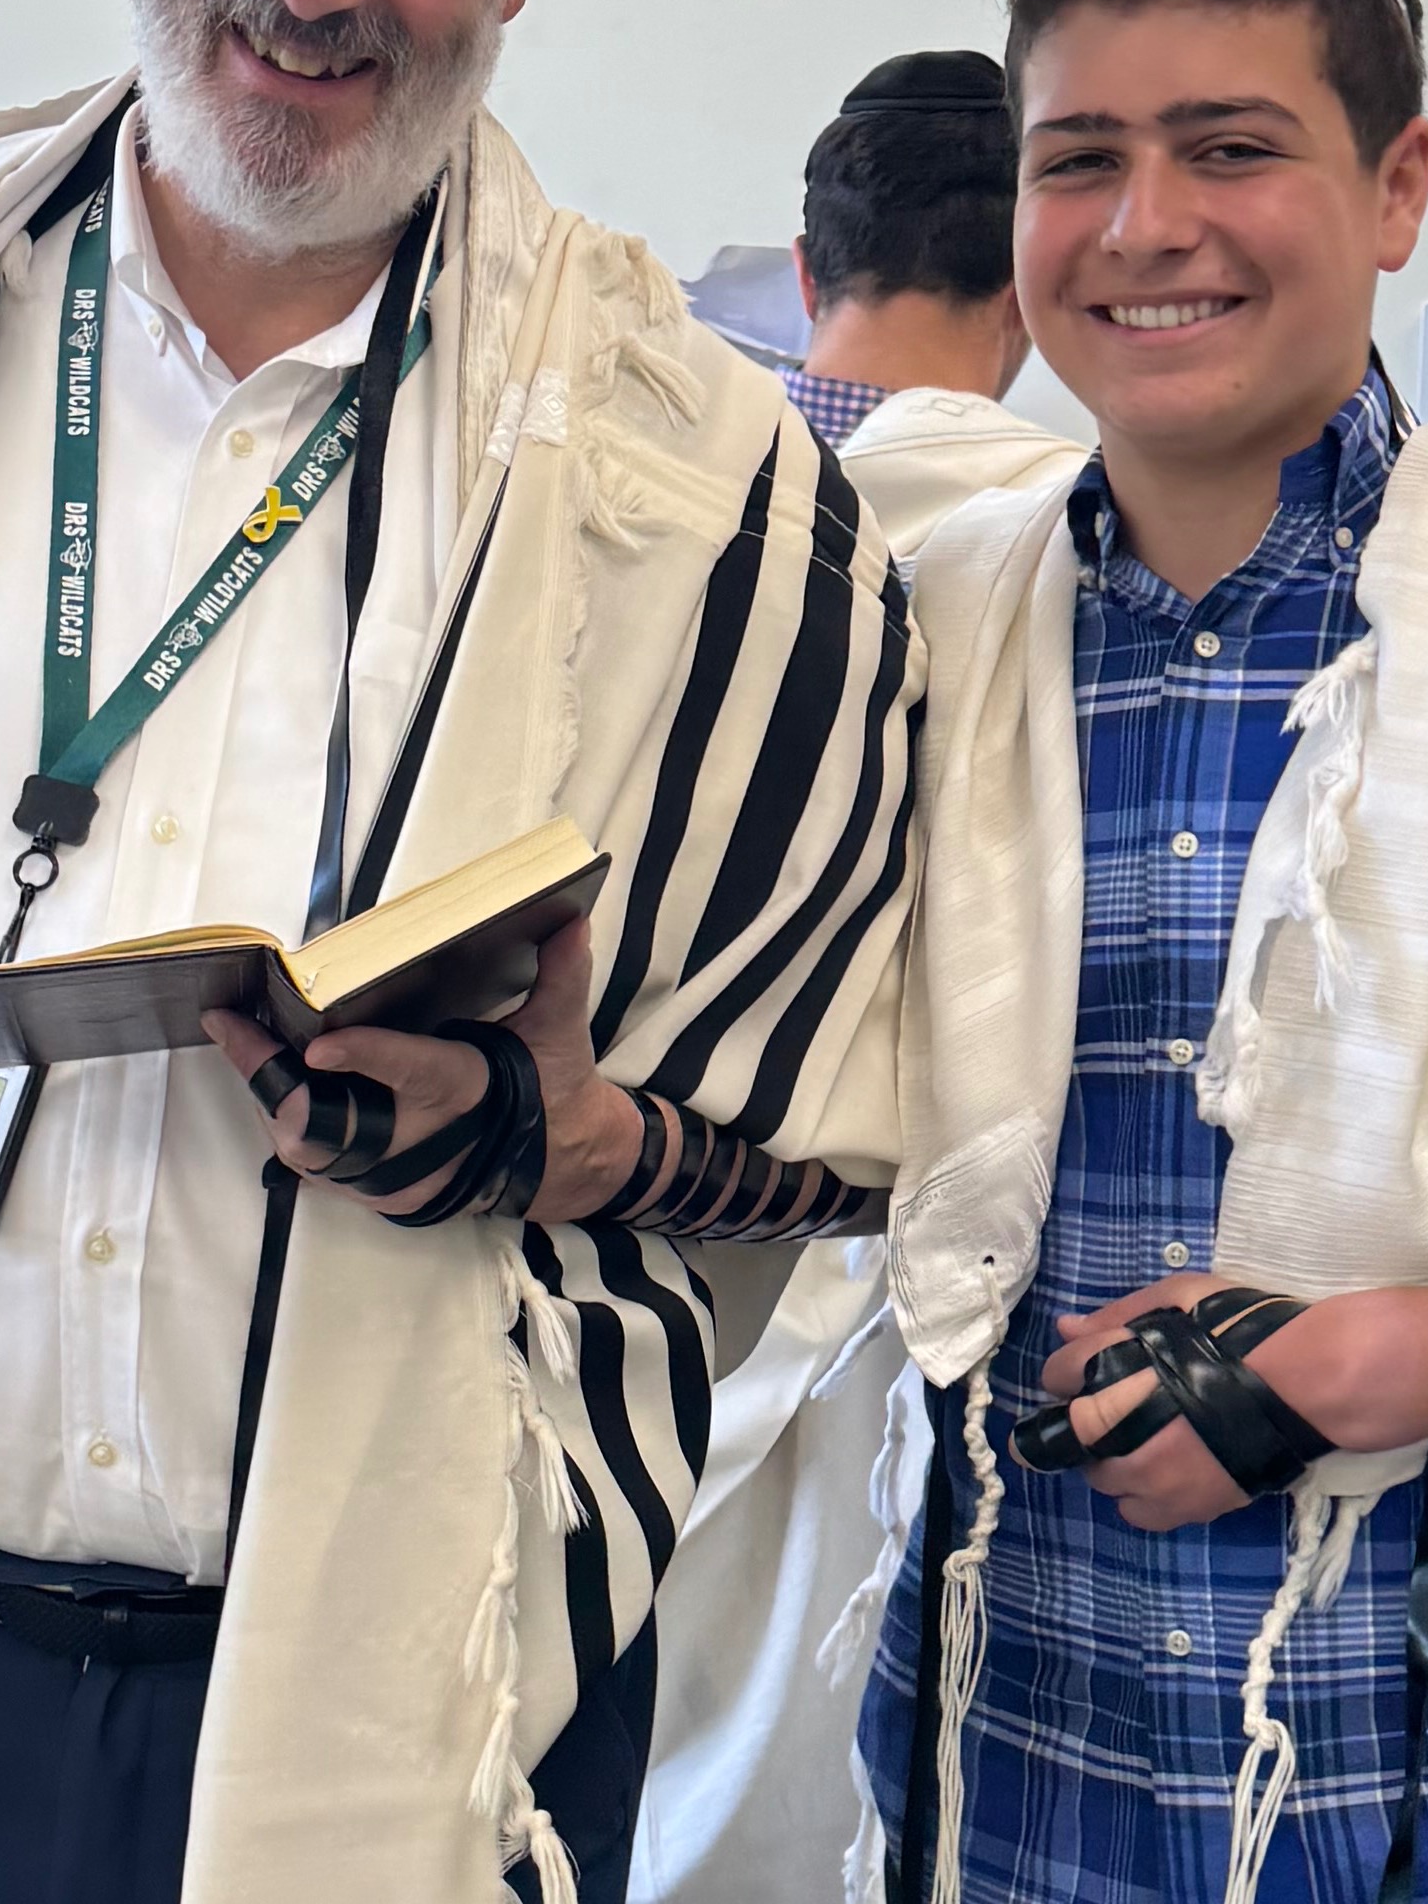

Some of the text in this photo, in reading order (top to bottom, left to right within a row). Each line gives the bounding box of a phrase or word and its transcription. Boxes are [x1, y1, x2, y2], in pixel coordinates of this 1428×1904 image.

[67, 288, 96, 437] DRS WILDCATS
[291, 461, 328, 502] DRS
[57, 501, 88, 658] DRS WILDCATS
[143, 546, 263, 692] DRS WILDCATS
